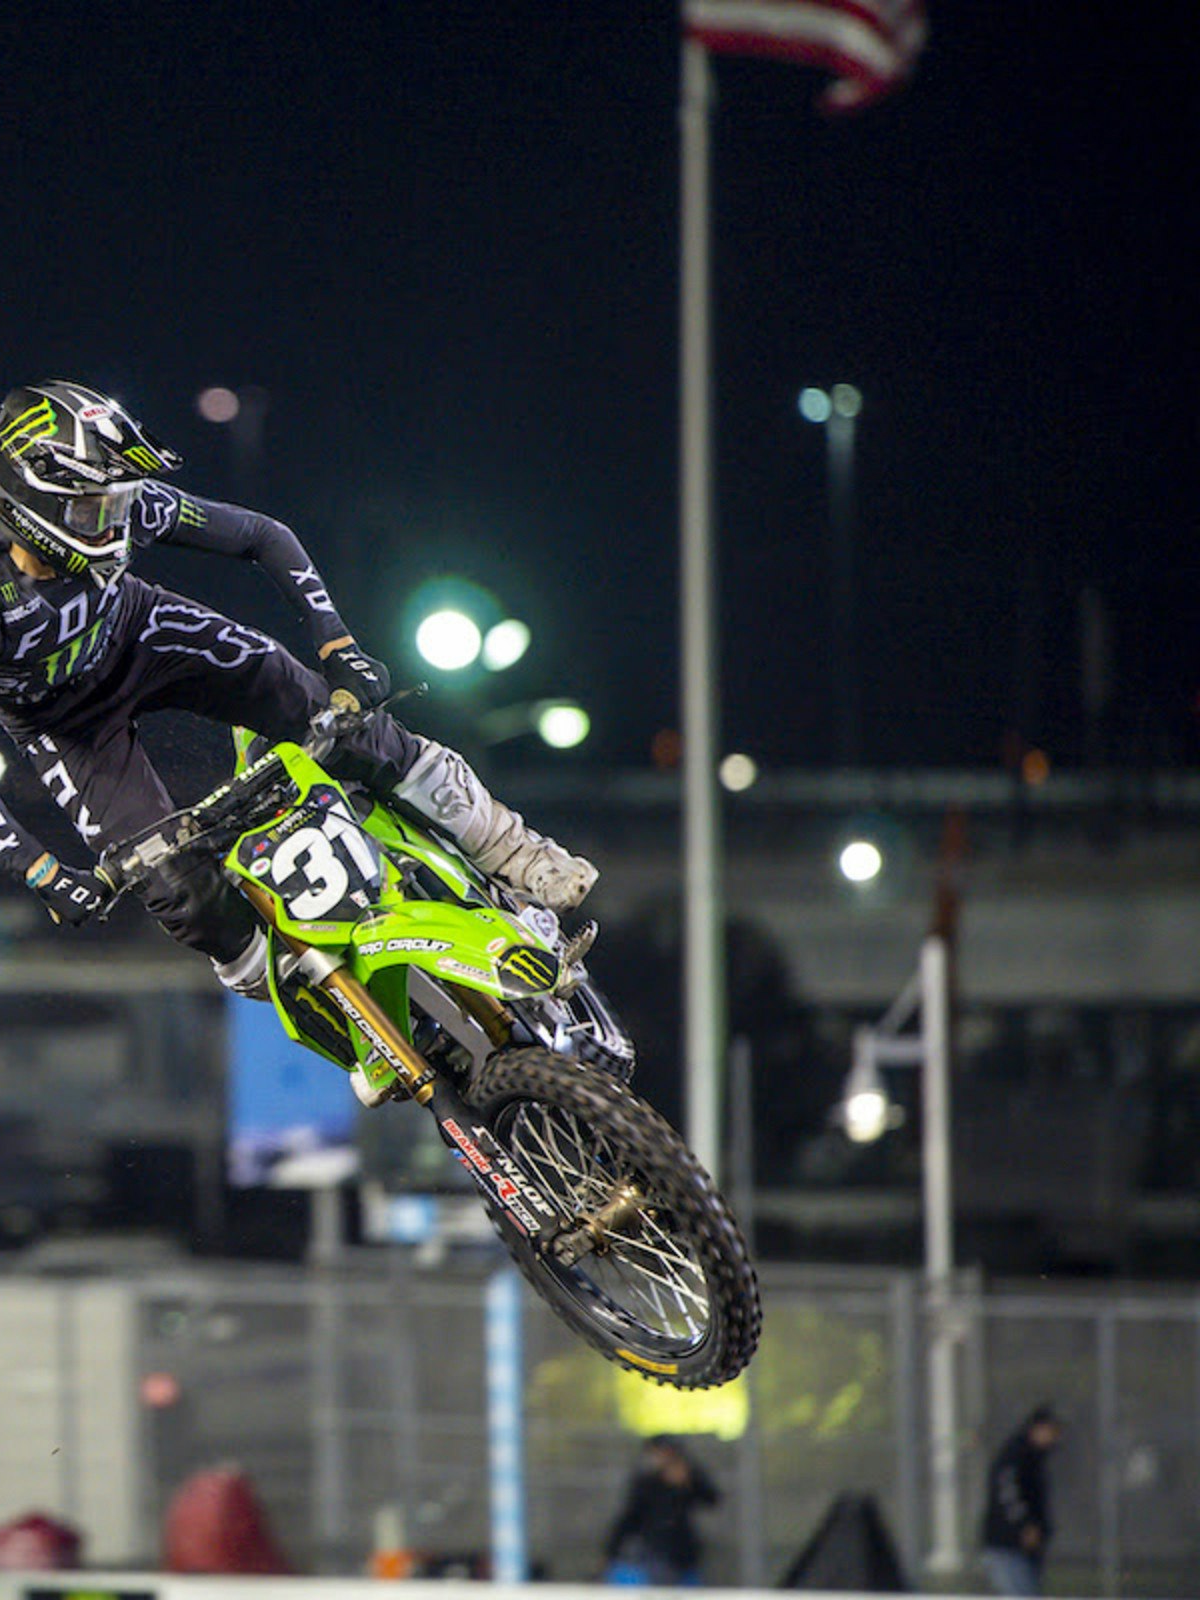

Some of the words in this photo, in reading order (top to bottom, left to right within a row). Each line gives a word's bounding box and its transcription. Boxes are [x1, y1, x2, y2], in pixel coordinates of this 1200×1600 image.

[271, 801, 379, 921] 31
[386, 938, 454, 952] CIRCUIT
[328, 987, 361, 1020] PRO
[356, 1019, 411, 1075] CIRCUIT
[471, 1126, 556, 1216] NLOP
